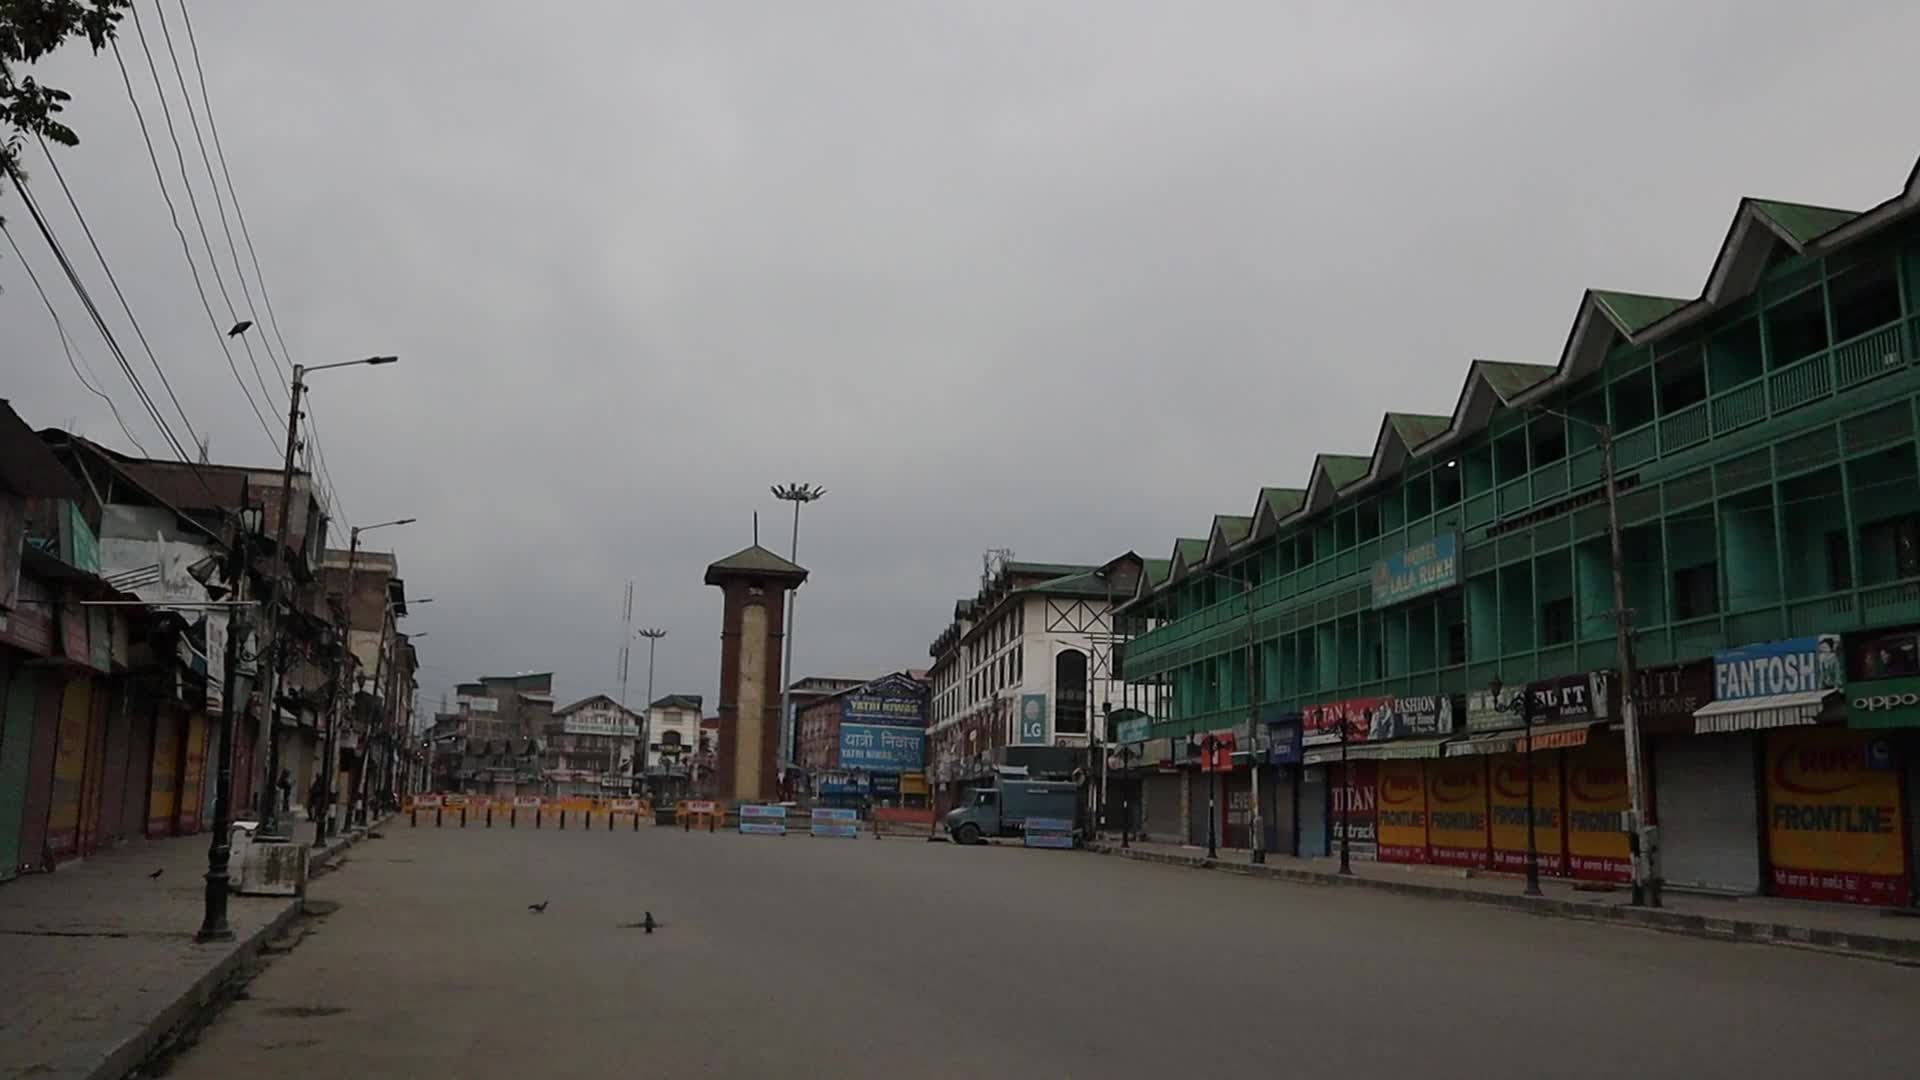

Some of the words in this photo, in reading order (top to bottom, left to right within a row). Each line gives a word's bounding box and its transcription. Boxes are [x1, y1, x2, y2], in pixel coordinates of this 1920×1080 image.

[1420, 556, 1455, 584] RUKH
[1716, 652, 1817, 699] FANTOSH
[1394, 696, 1436, 713] FASHION
[845, 729, 874, 748] यात्री
[881, 730, 921, 750] निवास
[1023, 722, 1042, 738] LG
[1331, 785, 1375, 812] TITAN
[1775, 804, 1896, 834] FRONTLINE
